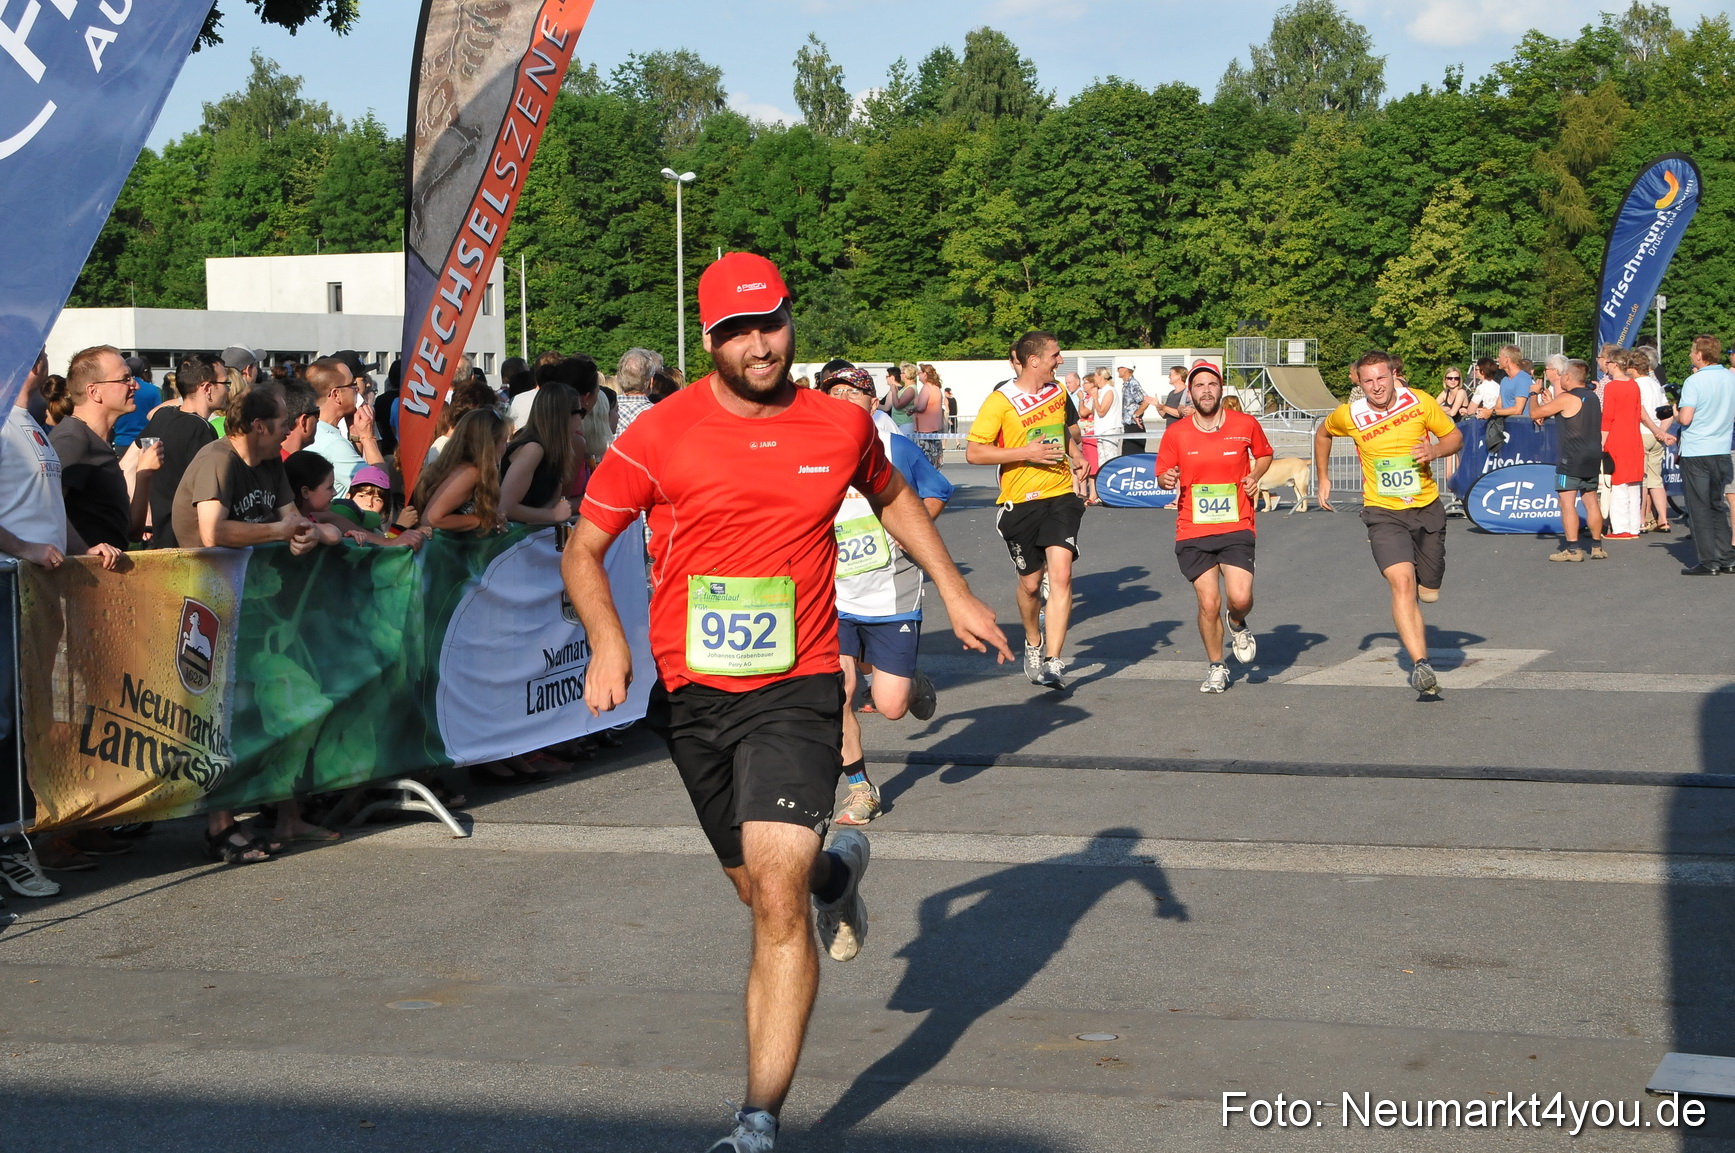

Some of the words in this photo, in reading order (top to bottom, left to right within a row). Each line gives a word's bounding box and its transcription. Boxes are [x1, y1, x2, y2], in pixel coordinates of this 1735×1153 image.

[402, 0, 569, 416] WECHSELSZENE.
[1603, 210, 1672, 319] Frischmann
[1616, 303, 1640, 348] mann-net.de
[1021, 410, 1047, 428] MAX
[1048, 398, 1066, 414] BÖG
[1361, 424, 1391, 442] MAX
[1392, 408, 1425, 427] BÖGL
[798, 465, 830, 474] Johannes
[1381, 470, 1414, 488] 805
[1198, 498, 1231, 513] 944
[838, 535, 877, 562] 528
[701, 611, 777, 651] 952
[185, 667, 204, 687] 1628
